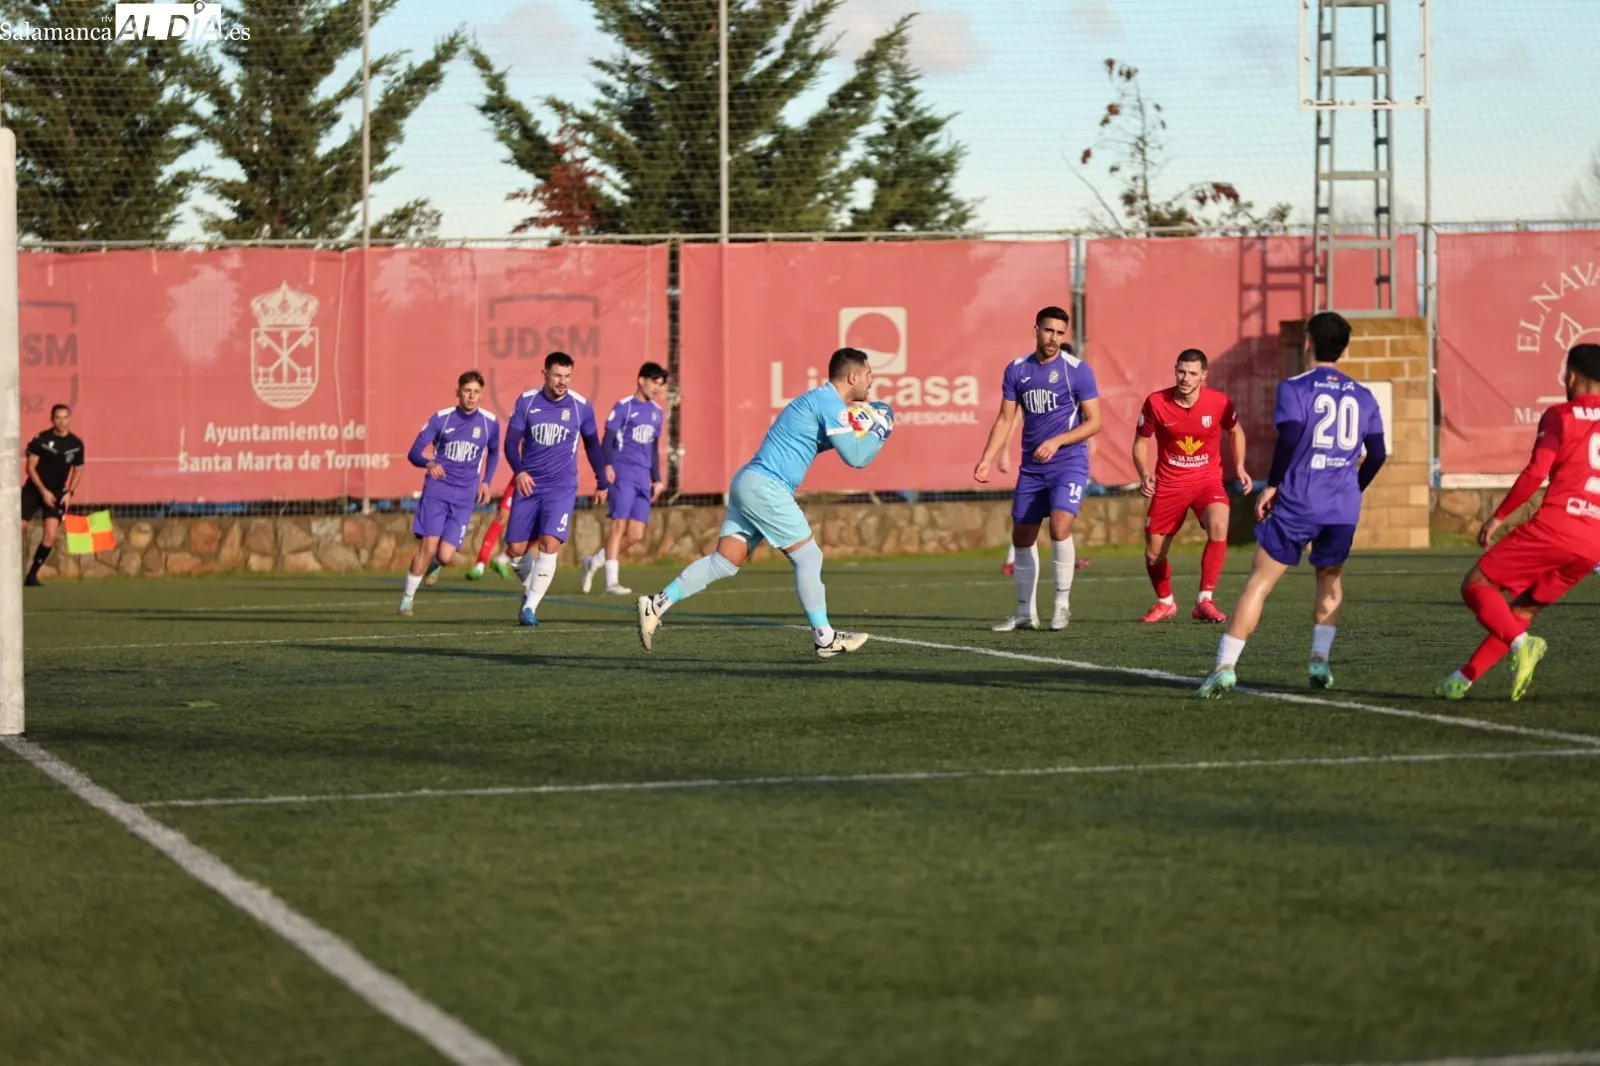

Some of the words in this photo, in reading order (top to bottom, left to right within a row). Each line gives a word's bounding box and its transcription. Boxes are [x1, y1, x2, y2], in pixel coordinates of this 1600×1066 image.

[488, 325, 601, 360] UDSM
[771, 361, 980, 409] Licasa
[204, 421, 339, 447] Ayuntamiento
[342, 420, 366, 441] de
[1312, 393, 1360, 450] 20
[178, 451, 233, 473] Santa
[237, 451, 294, 472] Marta
[298, 450, 321, 471] de
[325, 449, 390, 470] Tormes
